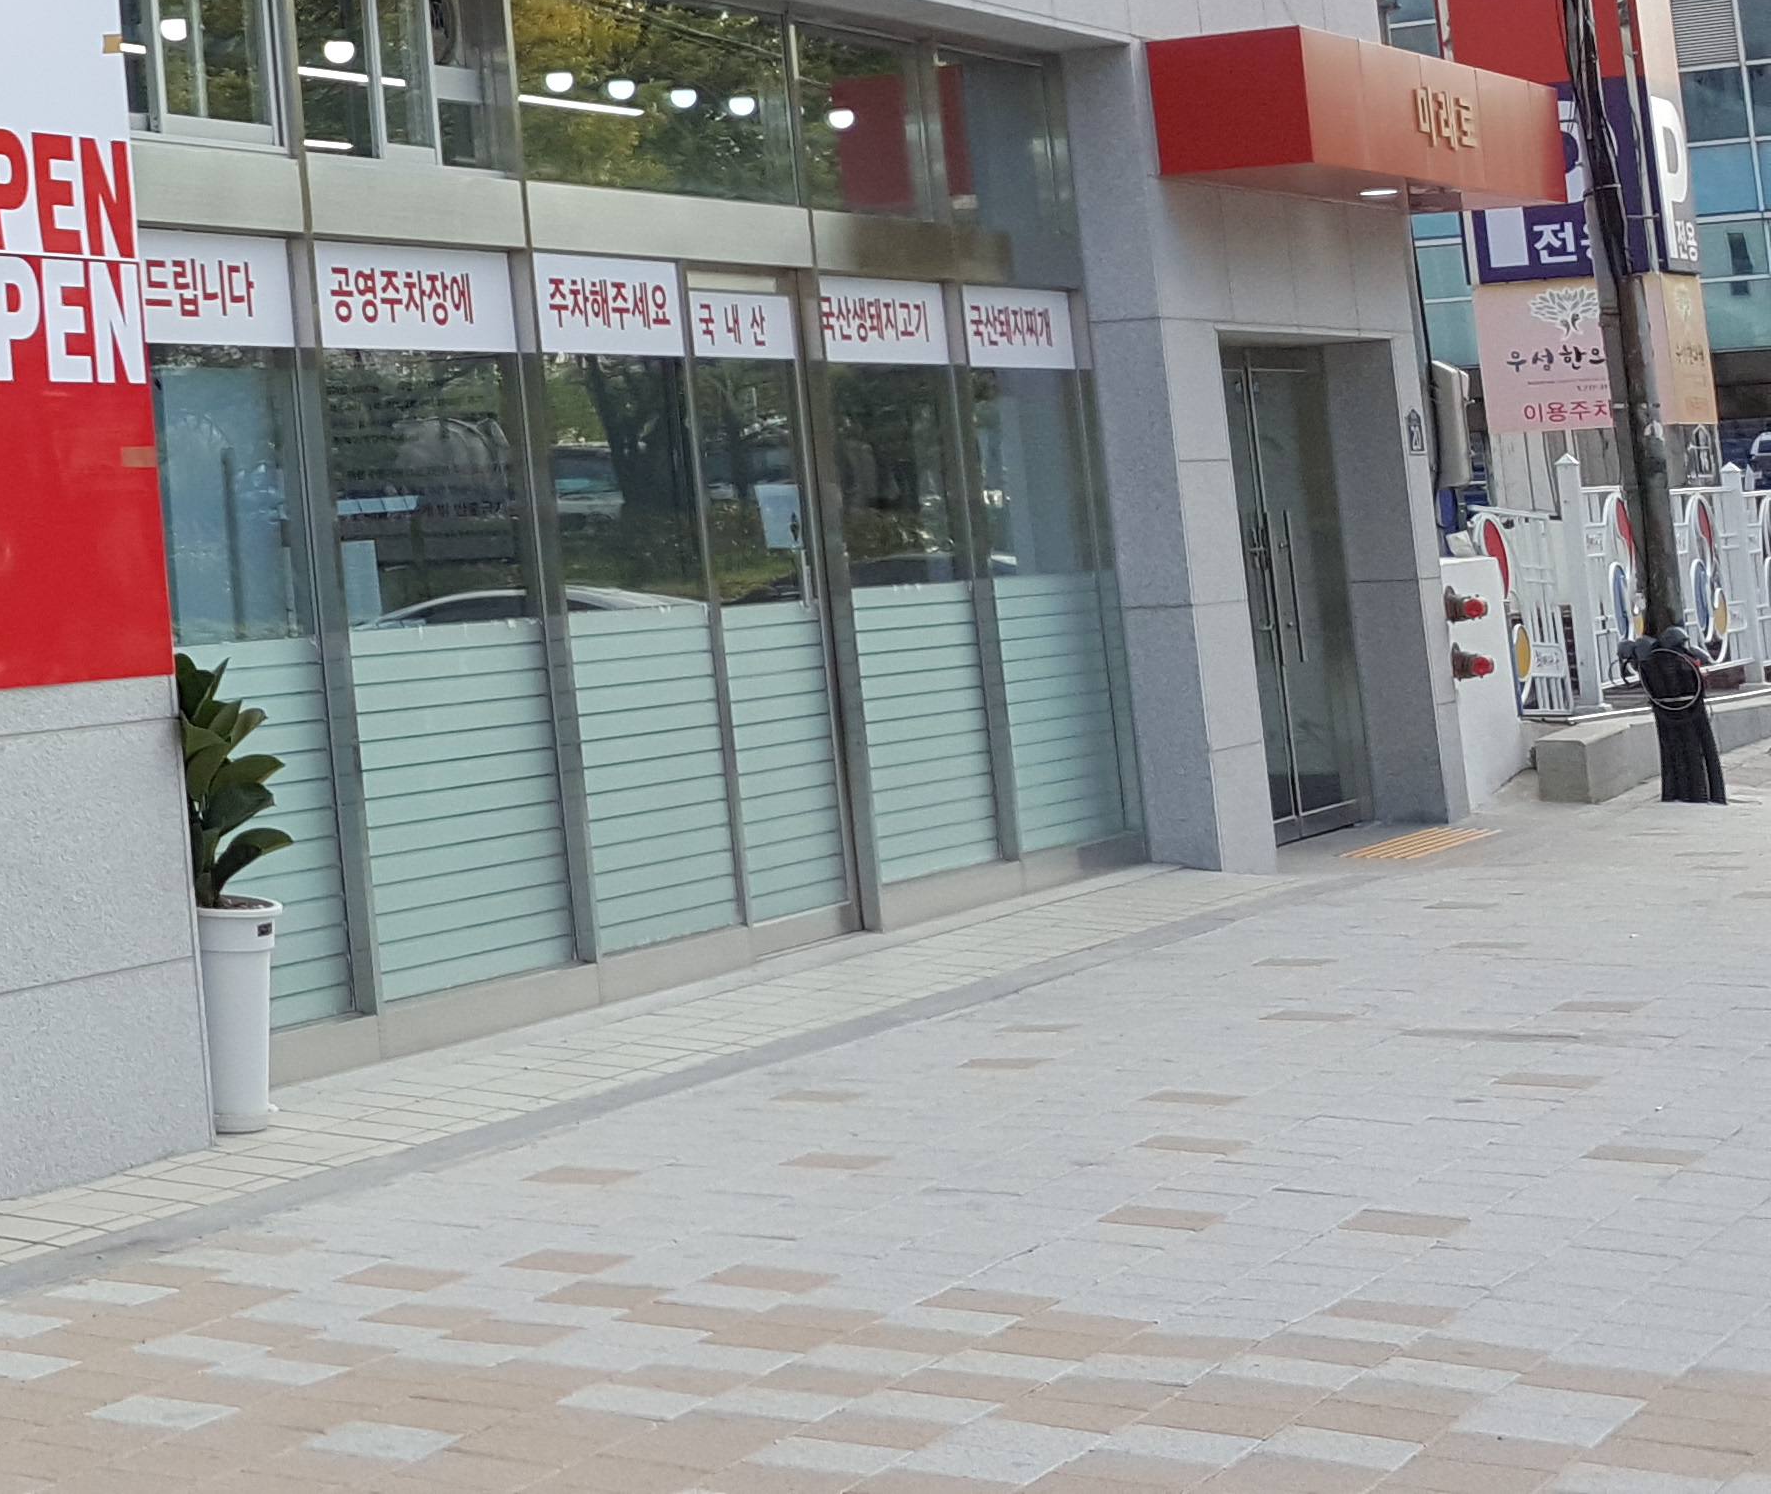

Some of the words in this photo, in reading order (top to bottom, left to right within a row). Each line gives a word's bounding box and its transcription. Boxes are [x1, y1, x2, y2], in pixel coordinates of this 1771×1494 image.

[1412, 86, 1478, 152] 미래로
[1533, 220, 1593, 265] 전
[144, 259, 255, 318] 드립니다
[329, 265, 476, 326] 공영주차장에
[547, 275, 672, 330] 주차해주세요
[820, 296, 930, 343] 국산생돼지고기
[970, 305, 1054, 348] 국산돼지찌개
